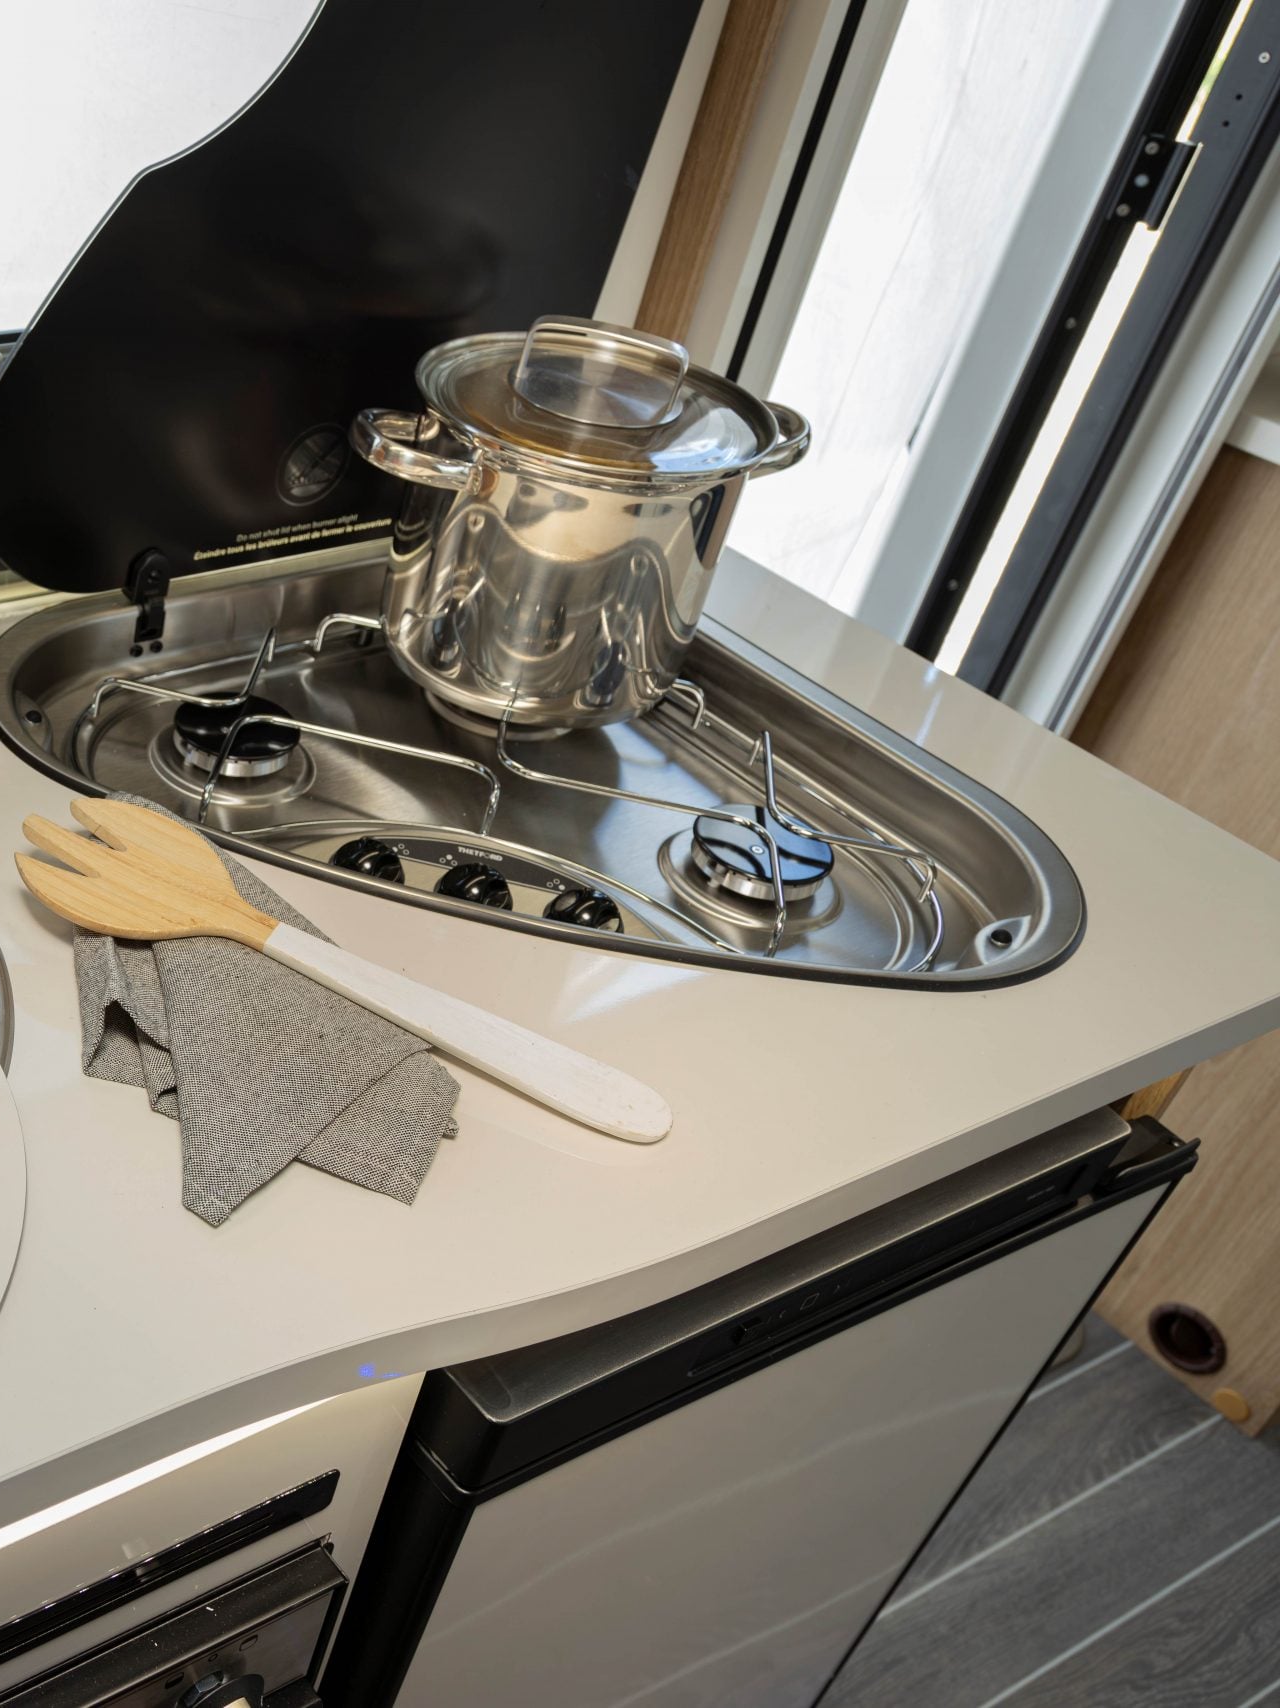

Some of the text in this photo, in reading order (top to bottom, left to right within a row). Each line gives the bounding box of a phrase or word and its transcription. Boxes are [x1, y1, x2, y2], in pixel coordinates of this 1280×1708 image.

[248, 530, 262, 540] not
[262, 527, 280, 537] shut
[291, 522, 312, 533] when
[312, 518, 337, 528] burner
[337, 513, 359, 525] alight
[227, 545, 244, 555] tous
[245, 542, 257, 551] les
[289, 532, 311, 543] avant
[311, 530, 321, 539] de
[321, 527, 346, 537] fermer
[458, 846, 503, 861] THETFORD
